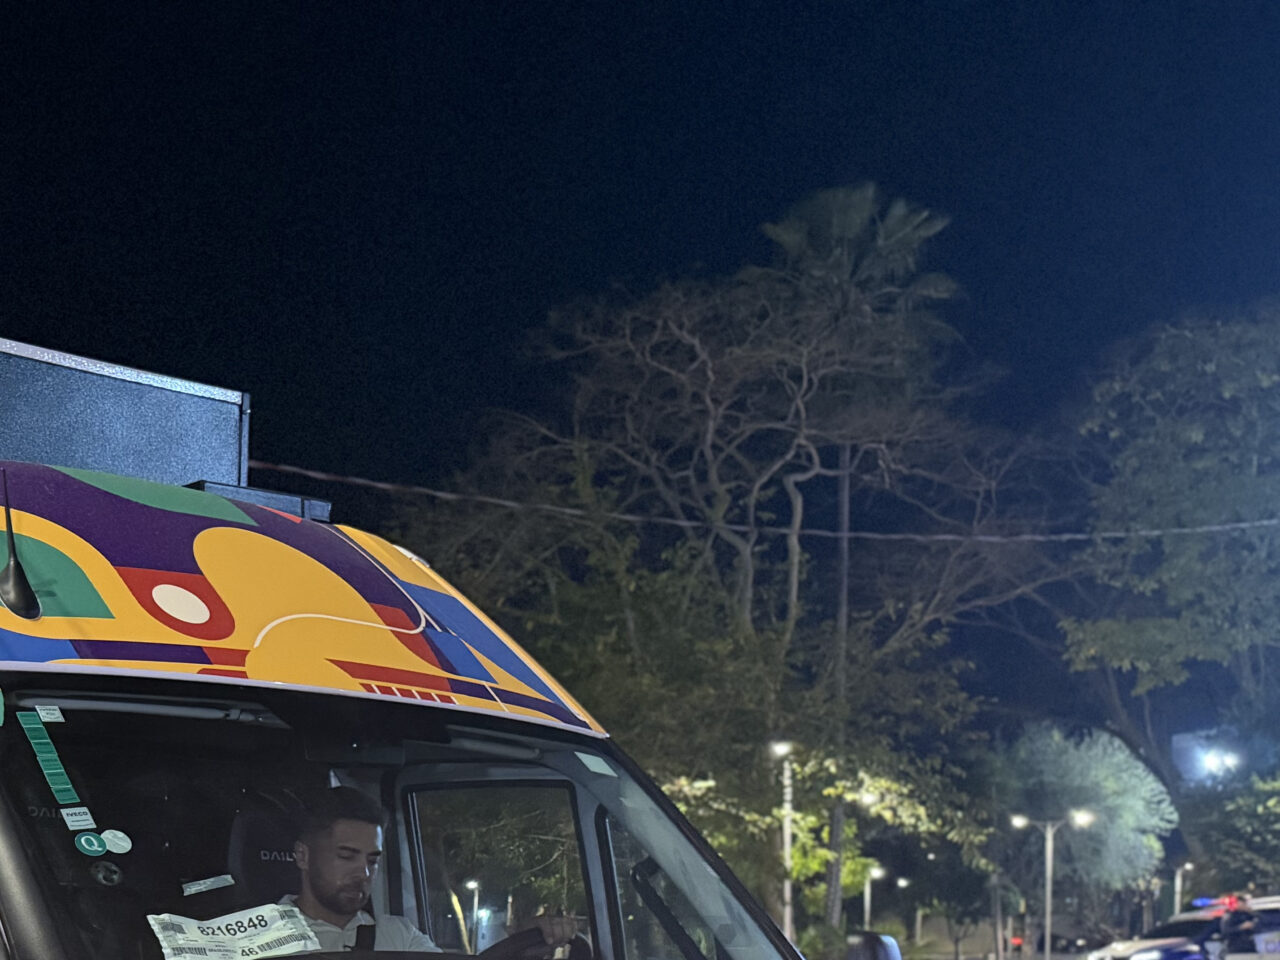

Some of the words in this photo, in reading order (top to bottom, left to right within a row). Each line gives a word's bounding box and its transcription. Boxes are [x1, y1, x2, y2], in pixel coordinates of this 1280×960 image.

[81, 835, 103, 851] Q
[197, 914, 269, 937] 8216848
[240, 947, 259, 958] 46
